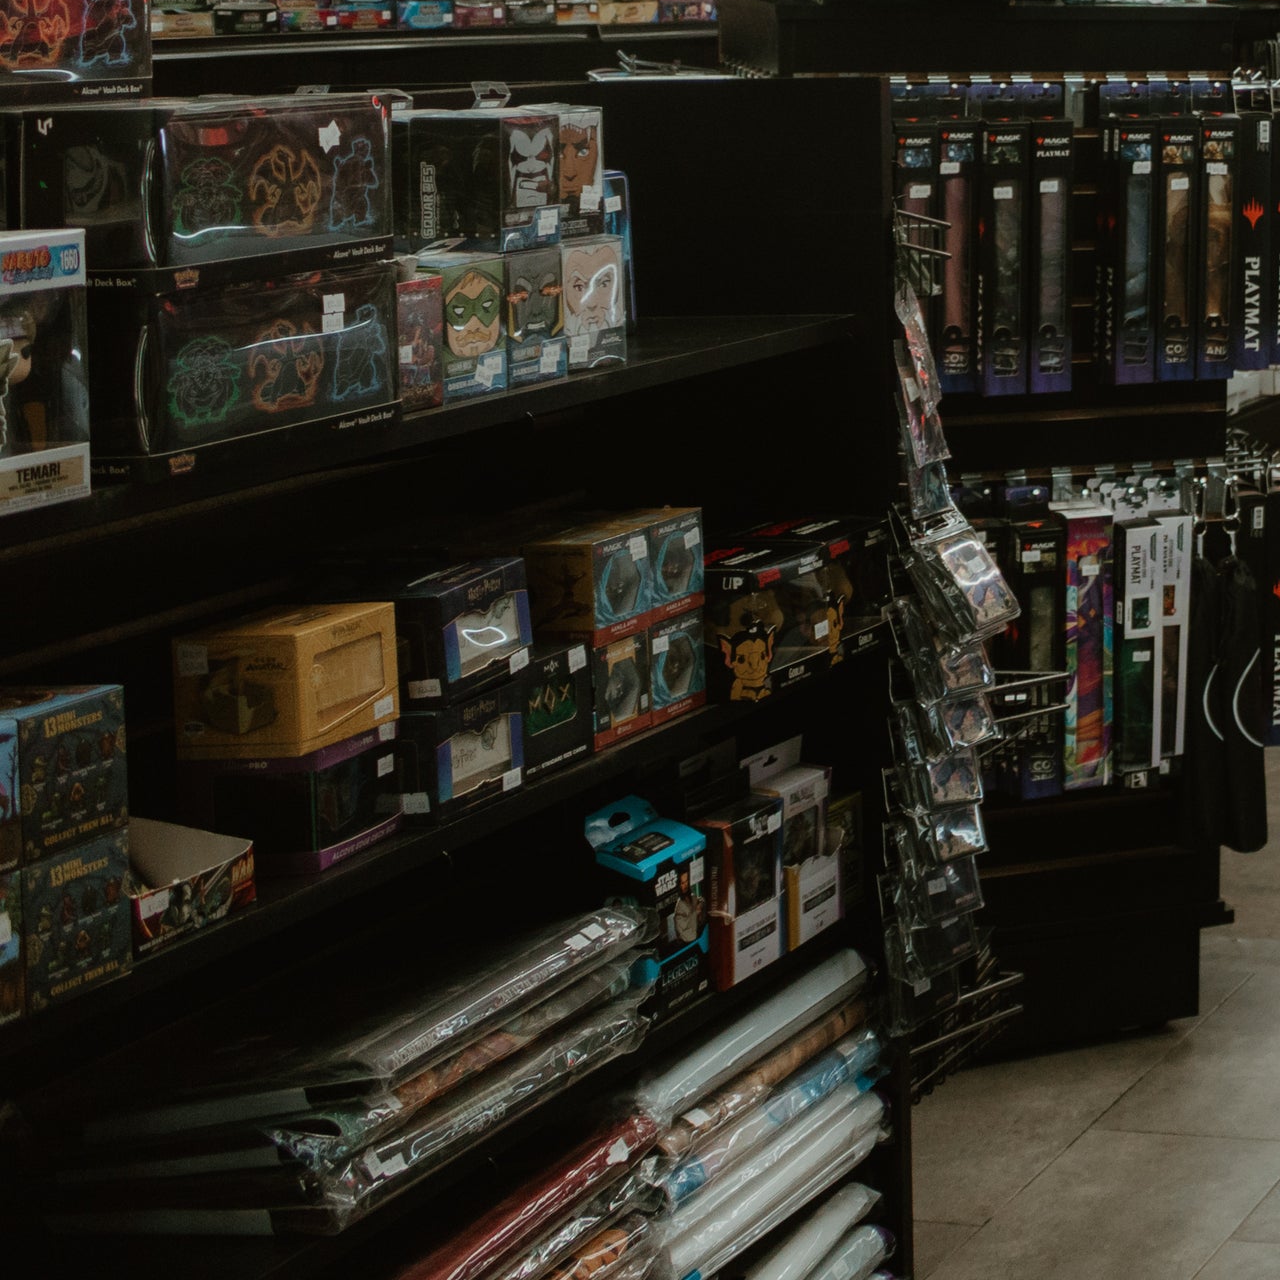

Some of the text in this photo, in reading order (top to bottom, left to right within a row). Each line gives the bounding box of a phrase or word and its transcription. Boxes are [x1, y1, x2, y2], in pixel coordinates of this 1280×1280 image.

[1036, 149, 1071, 158] PLAYMAT
[60, 251, 79, 269] 1660
[1243, 256, 1262, 352] PLAYMAT
[16, 462, 61, 482] TEMARI
[1129, 545, 1142, 586] PLAYMAT
[657, 870, 679, 886] STAR
